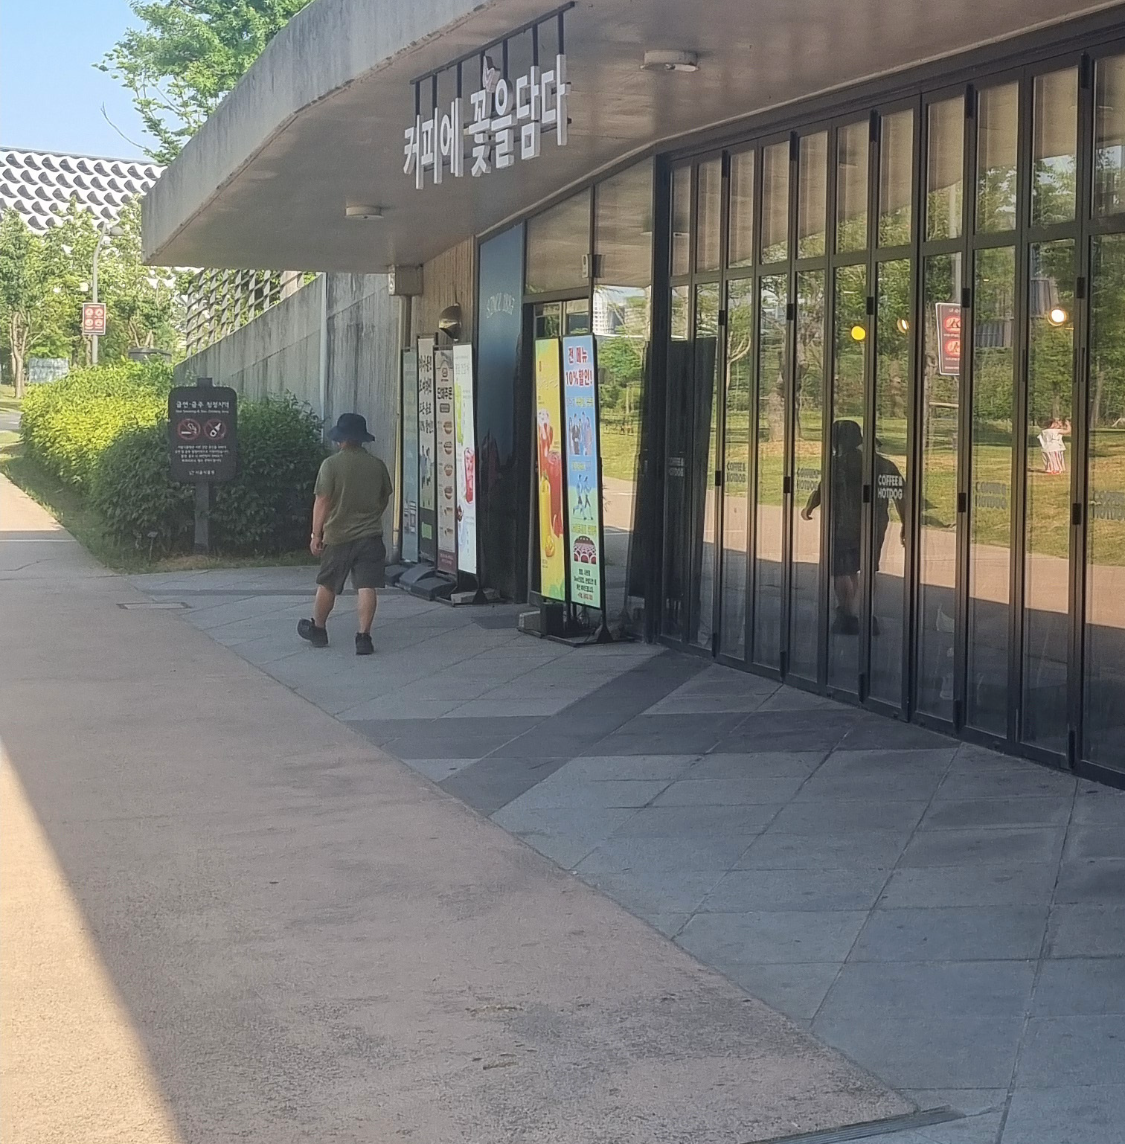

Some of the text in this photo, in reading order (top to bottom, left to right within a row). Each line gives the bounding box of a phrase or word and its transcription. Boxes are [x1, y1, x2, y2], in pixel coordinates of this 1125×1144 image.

[403, 97, 464, 190] 커피에
[568, 347, 574, 364] 전
[877, 474, 898, 486] COFFEE
[877, 488, 903, 500] HOTDOG
